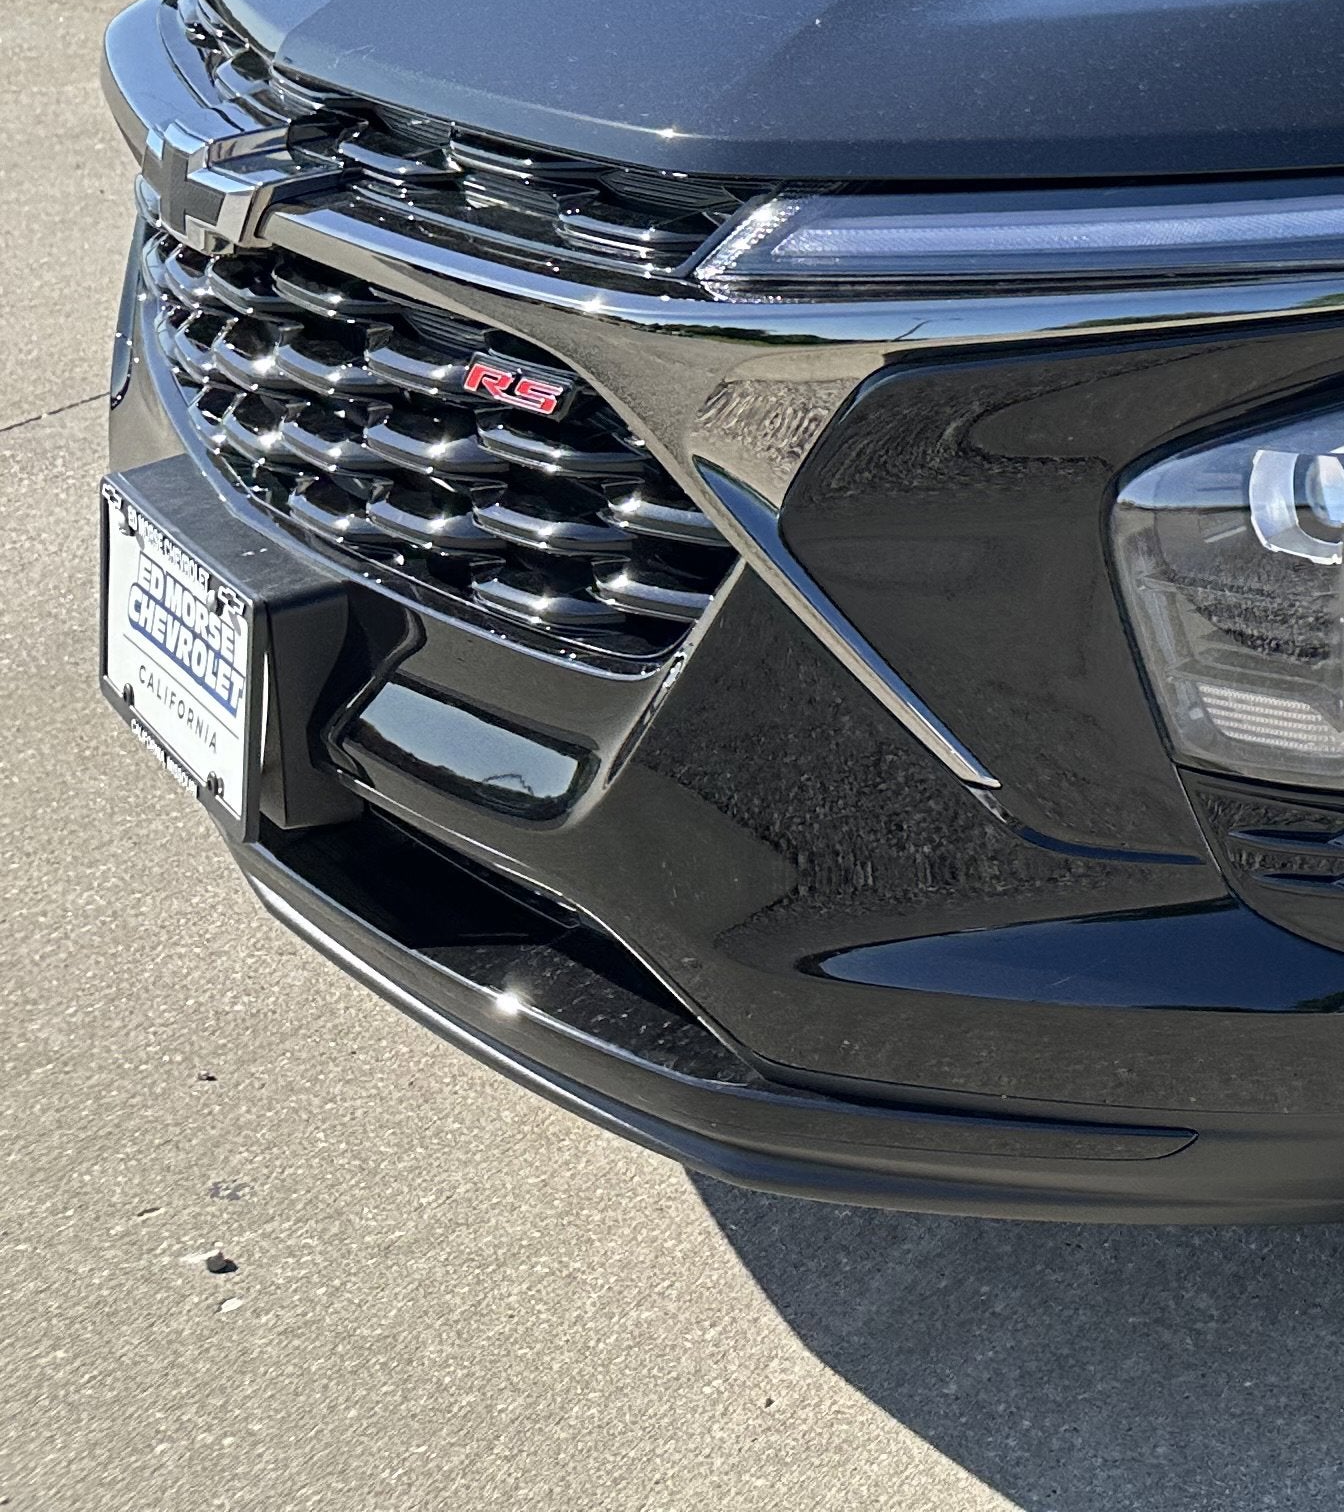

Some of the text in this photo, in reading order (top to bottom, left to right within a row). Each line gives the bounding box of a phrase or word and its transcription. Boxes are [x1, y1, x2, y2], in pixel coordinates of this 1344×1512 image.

[463, 363, 564, 415] RS
[128, 583, 246, 712] CHEVROLET
[138, 551, 235, 666] ED MORSE
[138, 664, 218, 754] CALIFORNIA
